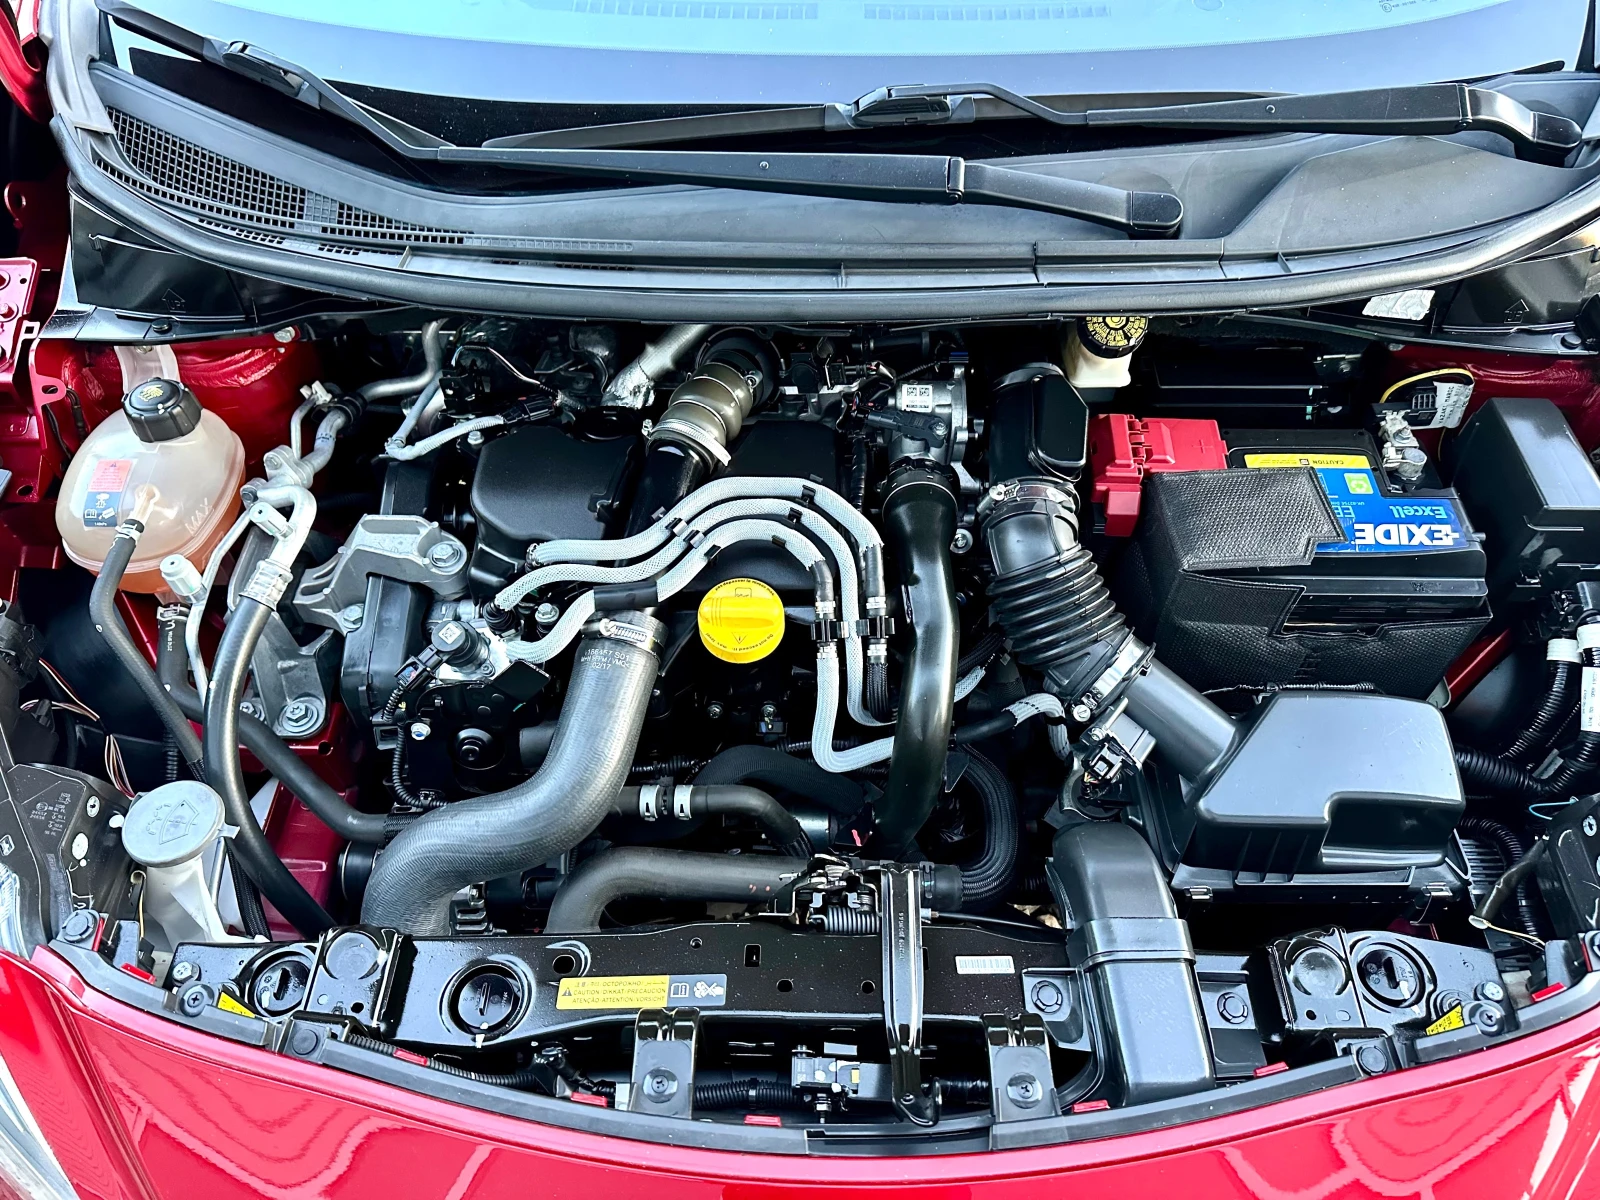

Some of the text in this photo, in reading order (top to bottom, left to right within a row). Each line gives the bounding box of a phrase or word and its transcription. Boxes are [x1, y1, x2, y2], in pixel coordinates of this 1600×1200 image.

[184, 497, 211, 535] MAX
[1389, 505, 1448, 519] Excell
[1353, 523, 1460, 547] EXIDE
[738, 643, 758, 652] exceed
[591, 661, 612, 671] 02/17
